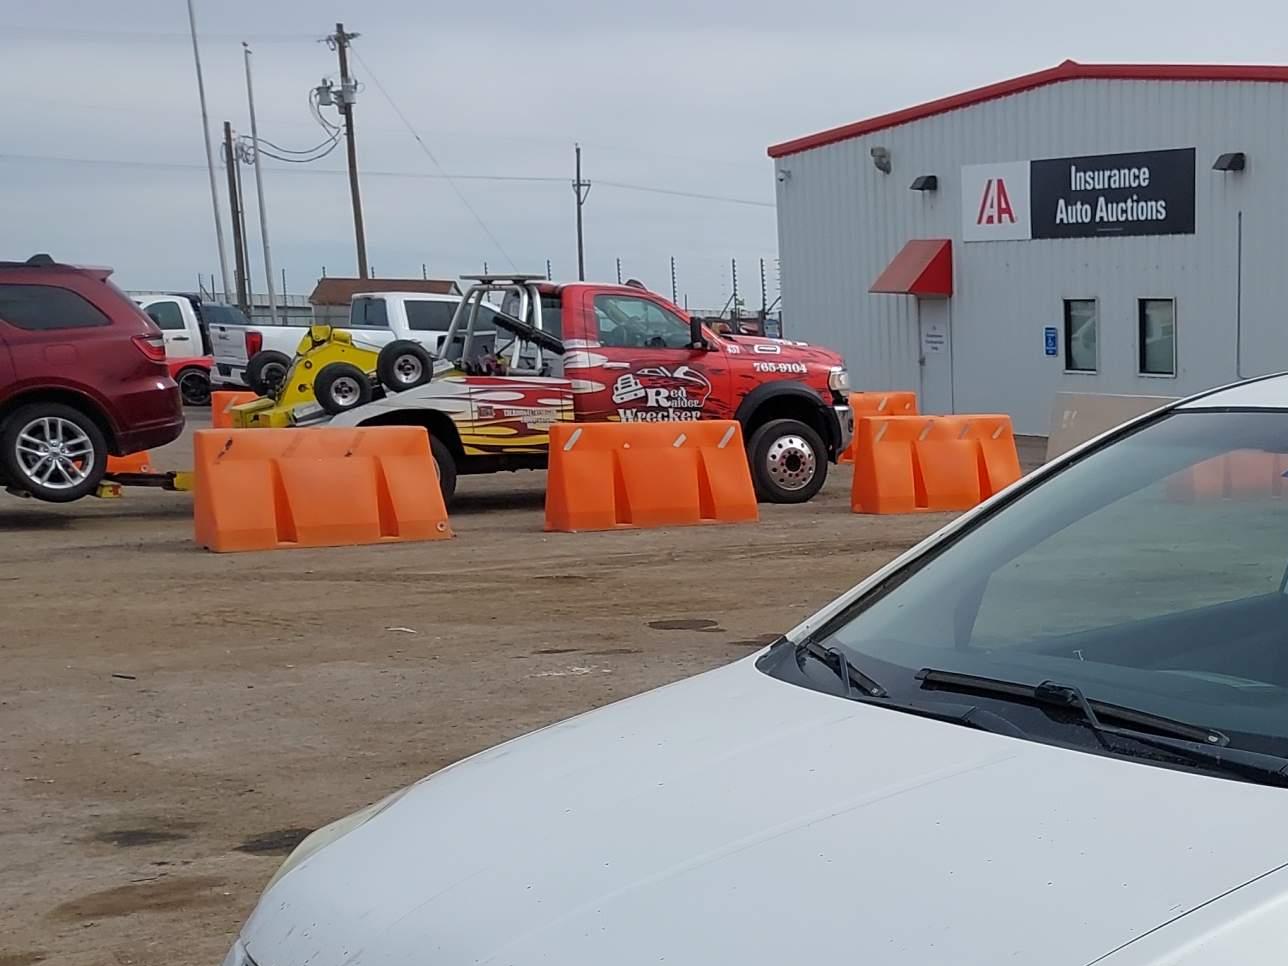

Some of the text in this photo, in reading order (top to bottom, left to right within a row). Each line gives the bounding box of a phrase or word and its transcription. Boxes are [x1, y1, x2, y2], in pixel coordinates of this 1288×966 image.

[1071, 165, 1149, 191] Insurance
[1055, 194, 1166, 224] Auto Auctions
[753, 361, 808, 373] 765-9104
[617, 407, 701, 423] Wrecker
